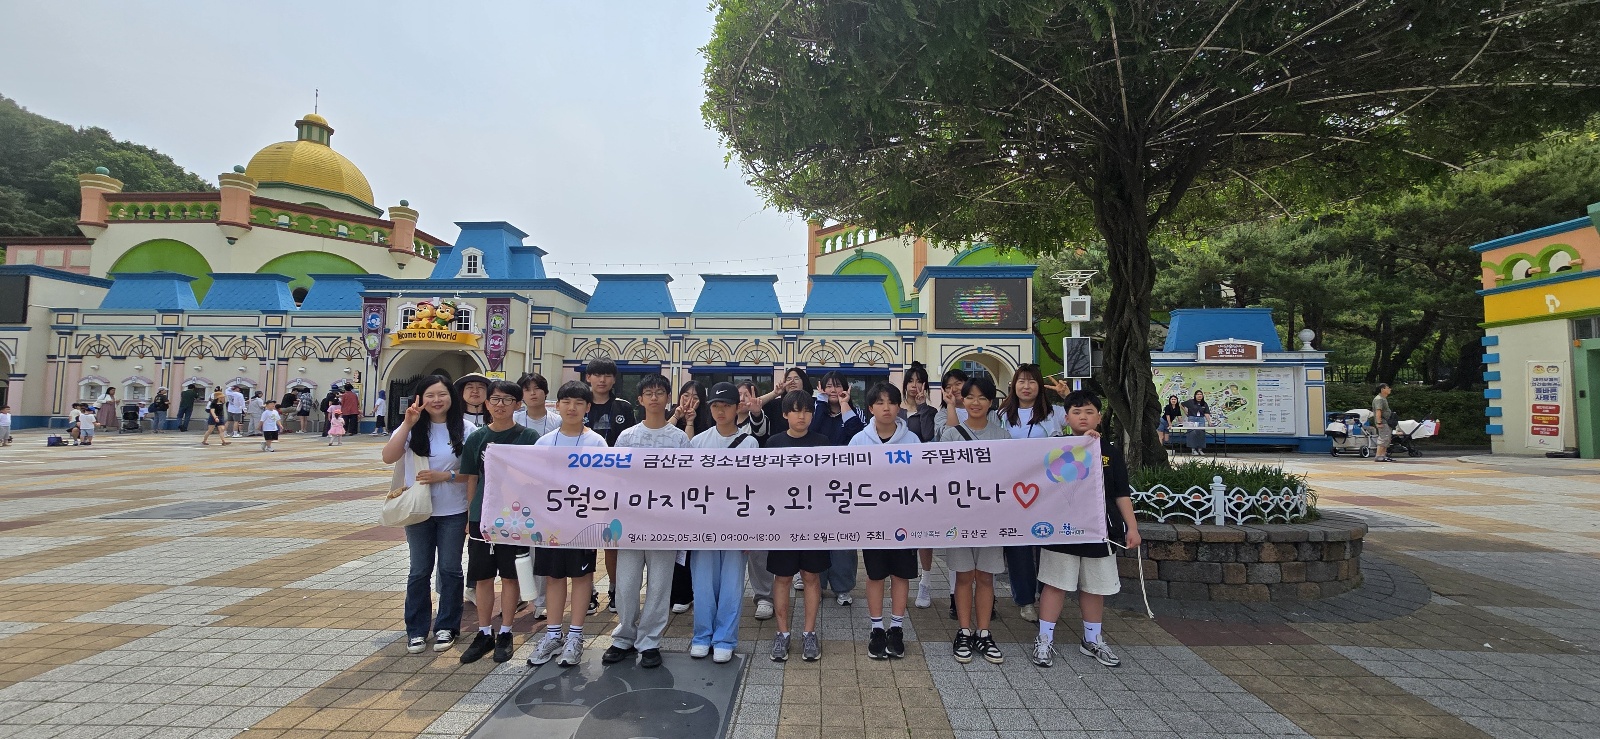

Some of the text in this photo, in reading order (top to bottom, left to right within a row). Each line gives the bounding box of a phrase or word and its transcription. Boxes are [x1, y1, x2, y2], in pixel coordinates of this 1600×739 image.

[436, 331, 457, 340] World
[567, 447, 992, 469] 2025년 금산군 청소년방과후아카데미 1차 주말체험
[546, 484, 618, 519] 5월의
[628, 484, 715, 515] 마지막
[725, 484, 756, 518] 날
[783, 484, 813, 511] 오!
[824, 479, 938, 515] 월드에서
[948, 479, 1007, 509] 만나
[627, 532, 781, 543] 일시: 2025.05.31(토) 09:00~18:00
[789, 531, 861, 543] 장소: 오월드(대전)
[910, 530, 941, 539] 여성족부
[960, 529, 988, 539] 금산군
